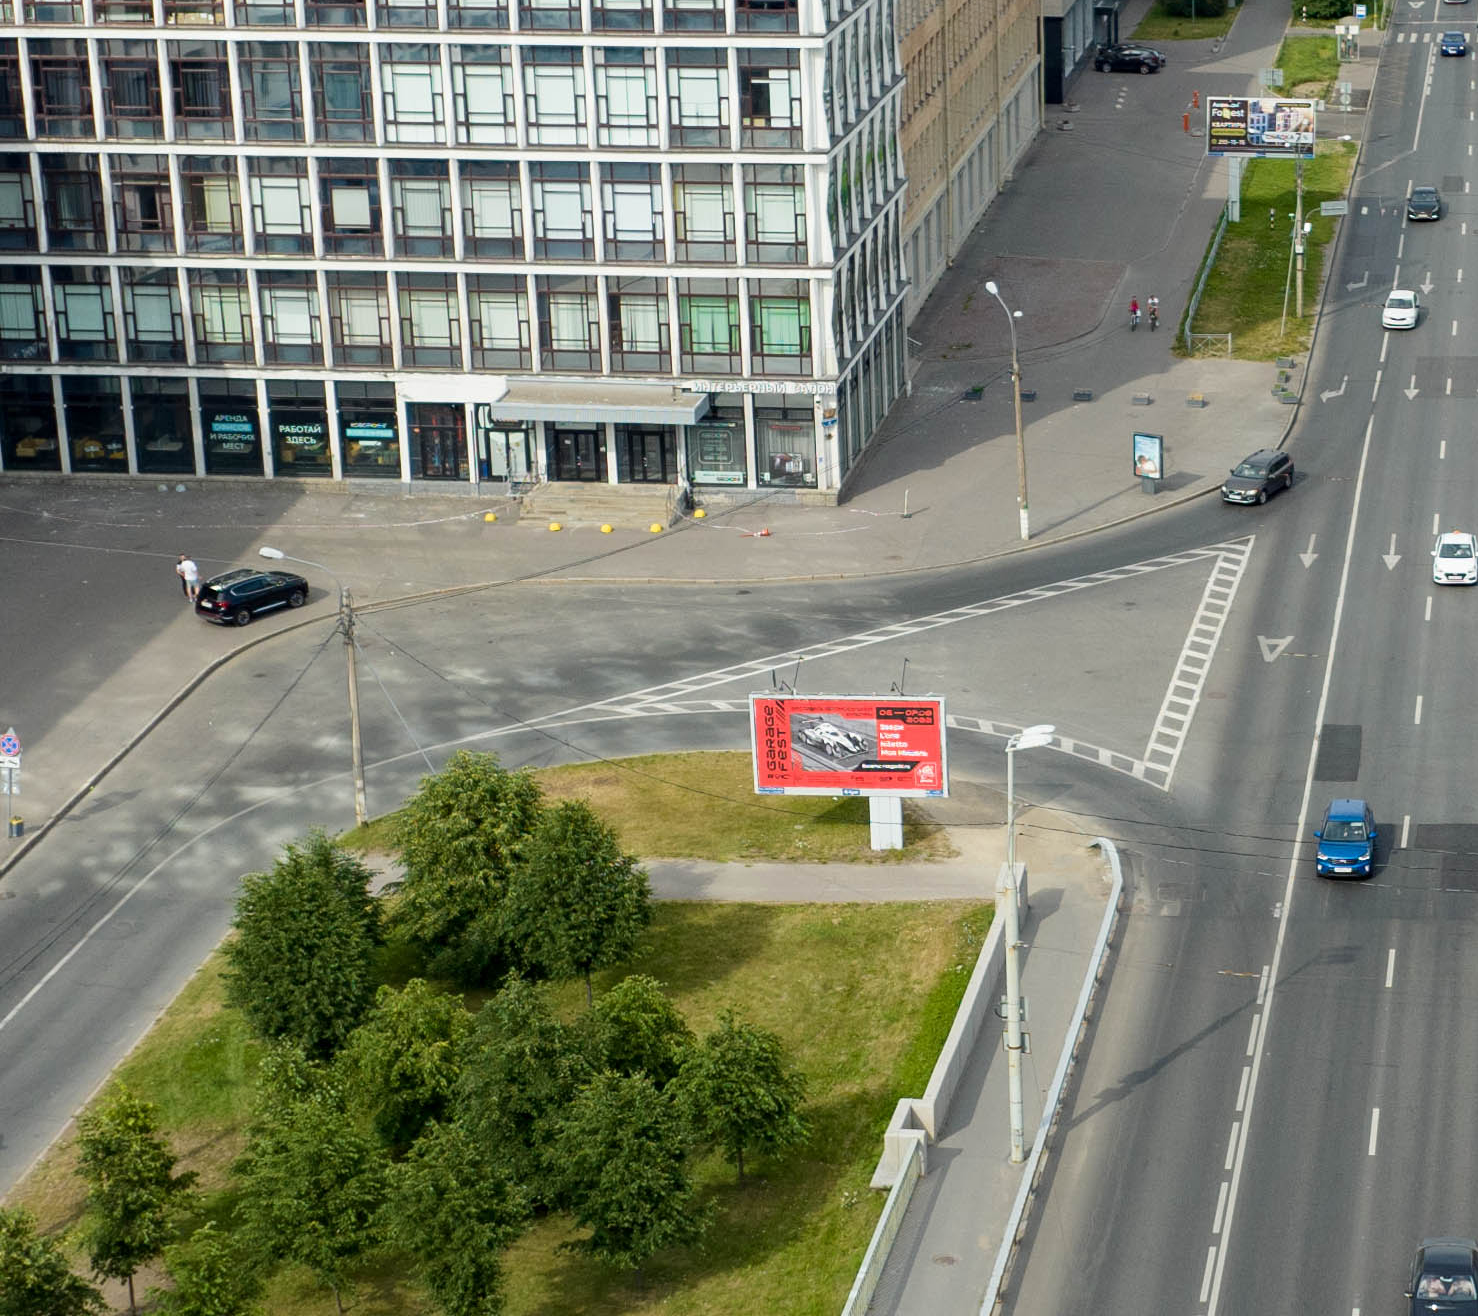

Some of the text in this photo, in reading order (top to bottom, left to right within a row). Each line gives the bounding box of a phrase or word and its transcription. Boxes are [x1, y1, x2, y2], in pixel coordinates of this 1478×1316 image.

[693, 382, 836, 394] ИНТЕРЬЕРНЫЙ САЛОН
[214, 414, 248, 422] АРЕНДА
[279, 423, 321, 433] РАБОТАЙ
[217, 433, 255, 442] РАБОЧИХ
[285, 436, 317, 445] ЗДЕСЬ
[222, 442, 245, 450] МЕСТ
